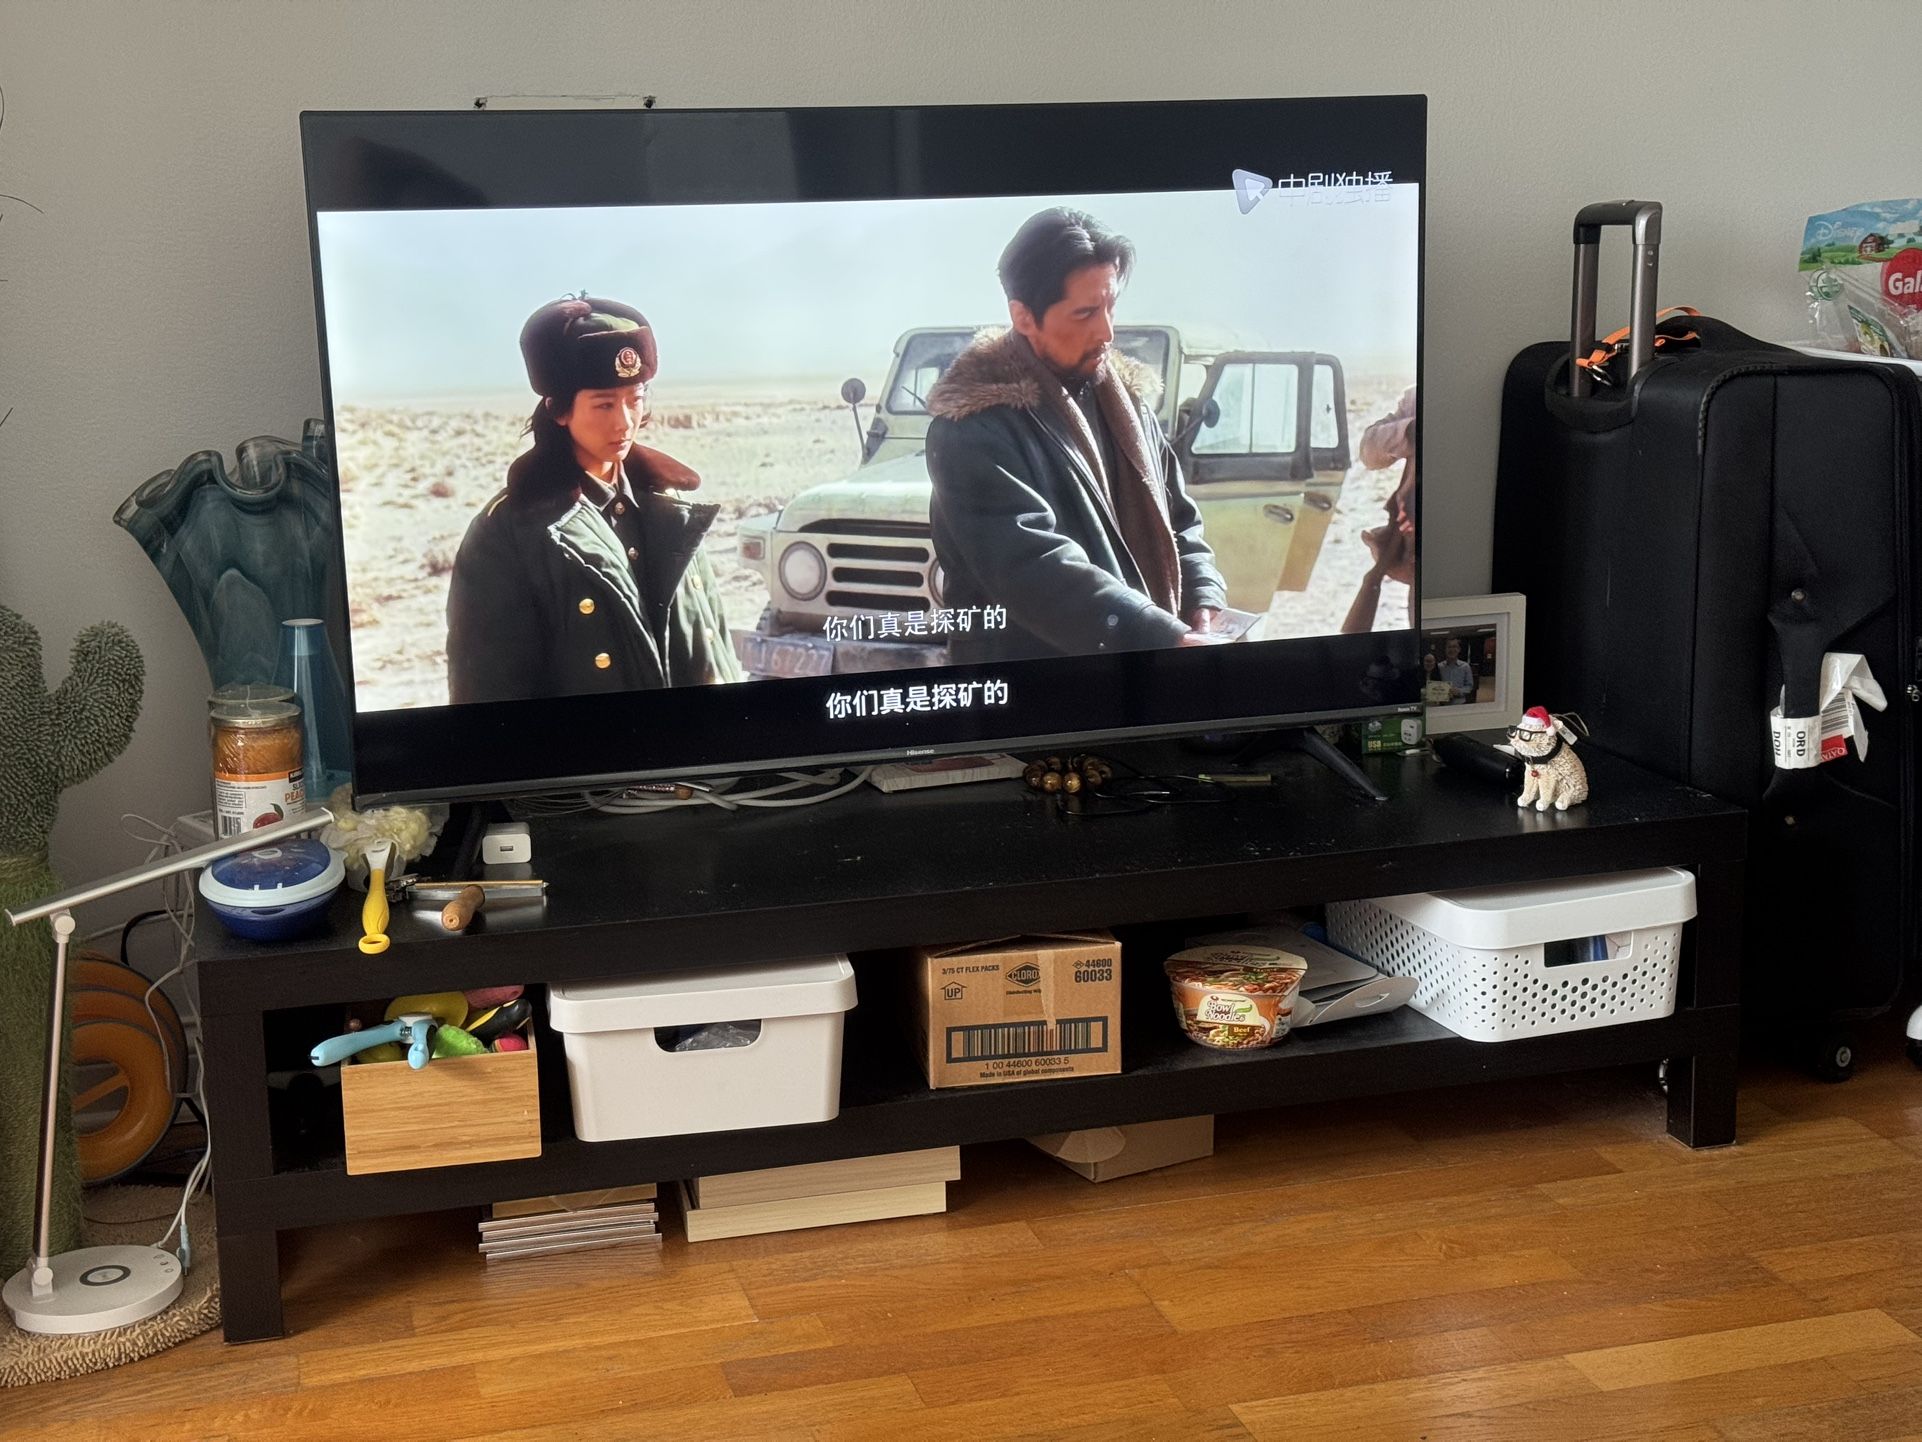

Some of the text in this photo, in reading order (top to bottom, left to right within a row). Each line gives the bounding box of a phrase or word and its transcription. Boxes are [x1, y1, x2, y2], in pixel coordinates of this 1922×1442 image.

[1815, 221, 1865, 243] Disney
[1888, 270, 1922, 296] Gal
[822, 604, 1007, 642] 你们真是探矿的
[825, 679, 1009, 719] 你们真是探矿的
[1796, 730, 1806, 757] ORD
[906, 748, 935, 756] Hisense
[980, 964, 1000, 972] PACKS
[1084, 958, 1113, 969] 44600
[1011, 970, 1041, 980] CLORO
[1074, 968, 1113, 984] 60033
[946, 987, 961, 998] UP
[1207, 1000, 1235, 1013] Bowl
[1205, 1010, 1246, 1022] Noodles
[992, 1061, 1003, 1069] 00
[1006, 1059, 1033, 1068] 44600
[1034, 1057, 1062, 1066] 60033
[1063, 1057, 1070, 1065] 5
[1003, 1069, 1015, 1077] USA
